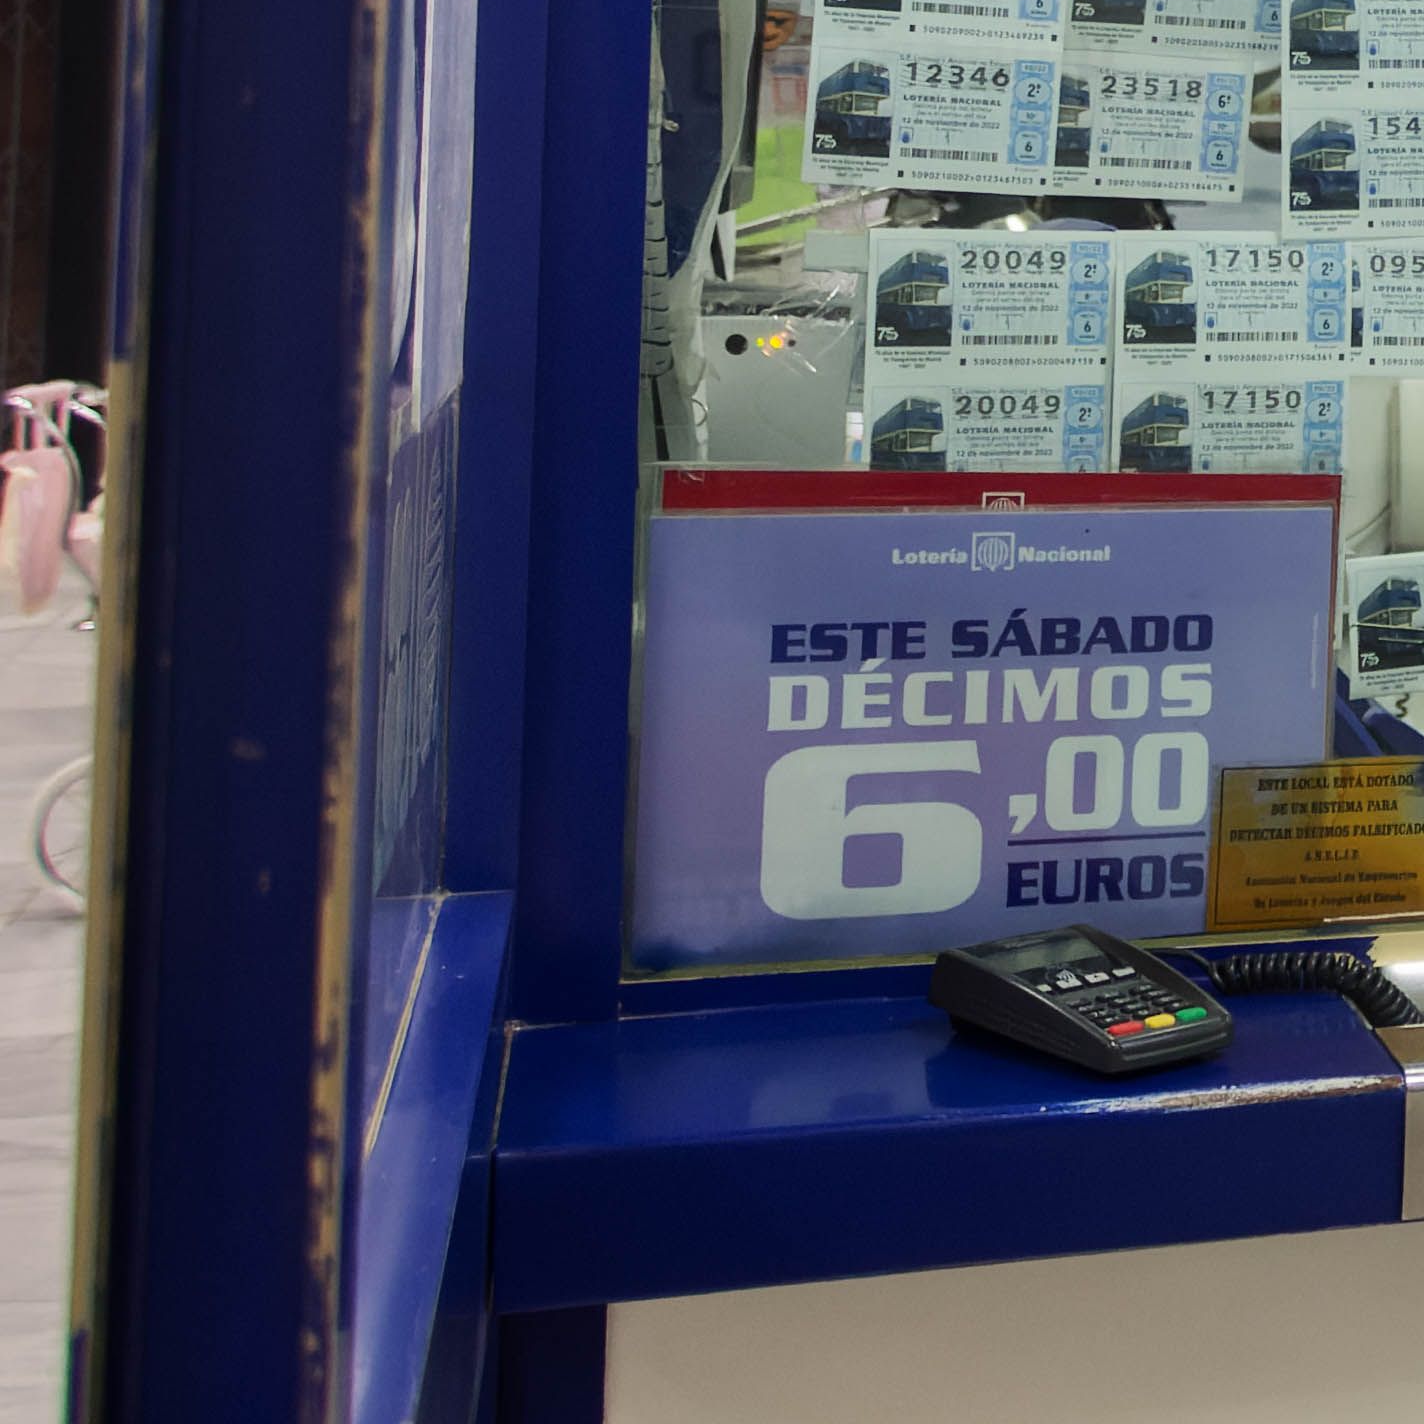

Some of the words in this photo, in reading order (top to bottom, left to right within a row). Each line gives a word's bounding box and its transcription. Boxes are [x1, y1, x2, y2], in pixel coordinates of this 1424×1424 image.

[961, 248, 1067, 271] 20049
[1205, 248, 1304, 269] 17150
[893, 547, 968, 566] Lotería
[1017, 544, 1111, 564] Nacional
[769, 619, 927, 664] ESTE
[950, 608, 1214, 660] SÁBADO
[765, 657, 1213, 732] DÉCIMOS
[760, 730, 1210, 920] 6,00
[1006, 852, 1206, 909] EUROS
